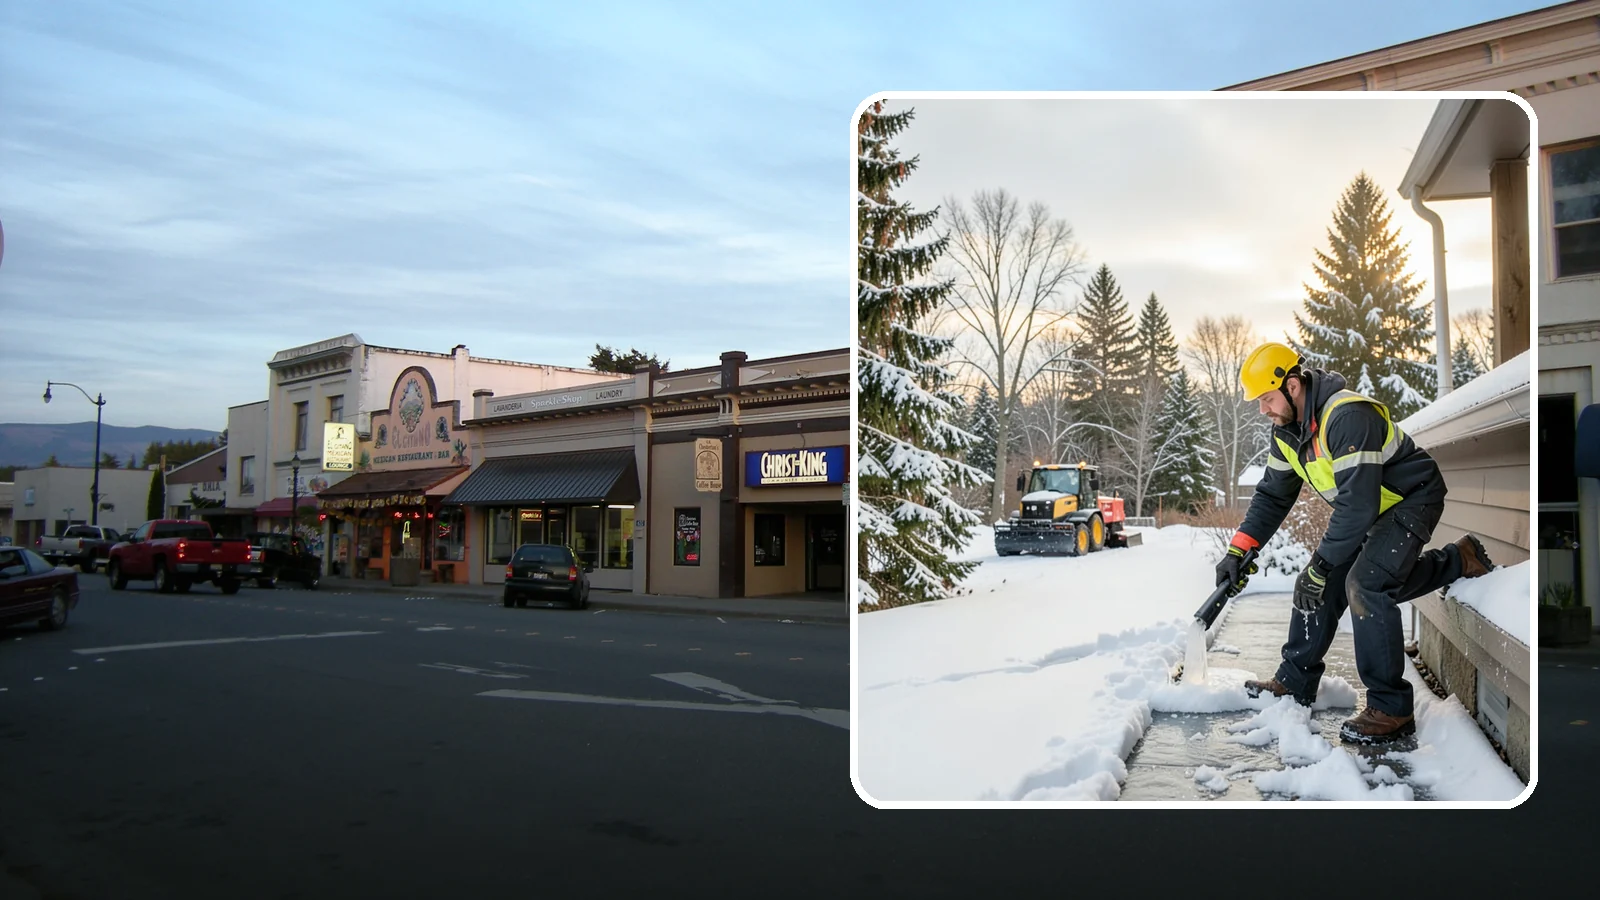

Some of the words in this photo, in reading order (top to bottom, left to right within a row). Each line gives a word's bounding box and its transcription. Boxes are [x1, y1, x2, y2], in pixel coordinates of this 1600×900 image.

[561, 394, 583, 405] Shop
[595, 389, 624, 400] LAUNDRY
[493, 402, 523, 413] LAVANDERIA
[373, 455, 396, 465] MEXICAN
[397, 451, 434, 463] RESTAURANT
[438, 450, 450, 460] BAR
[761, 452, 797, 478] CHRIST
[799, 450, 827, 477] KING
[696, 480, 709, 489] Coffee
[710, 480, 722, 489] House
